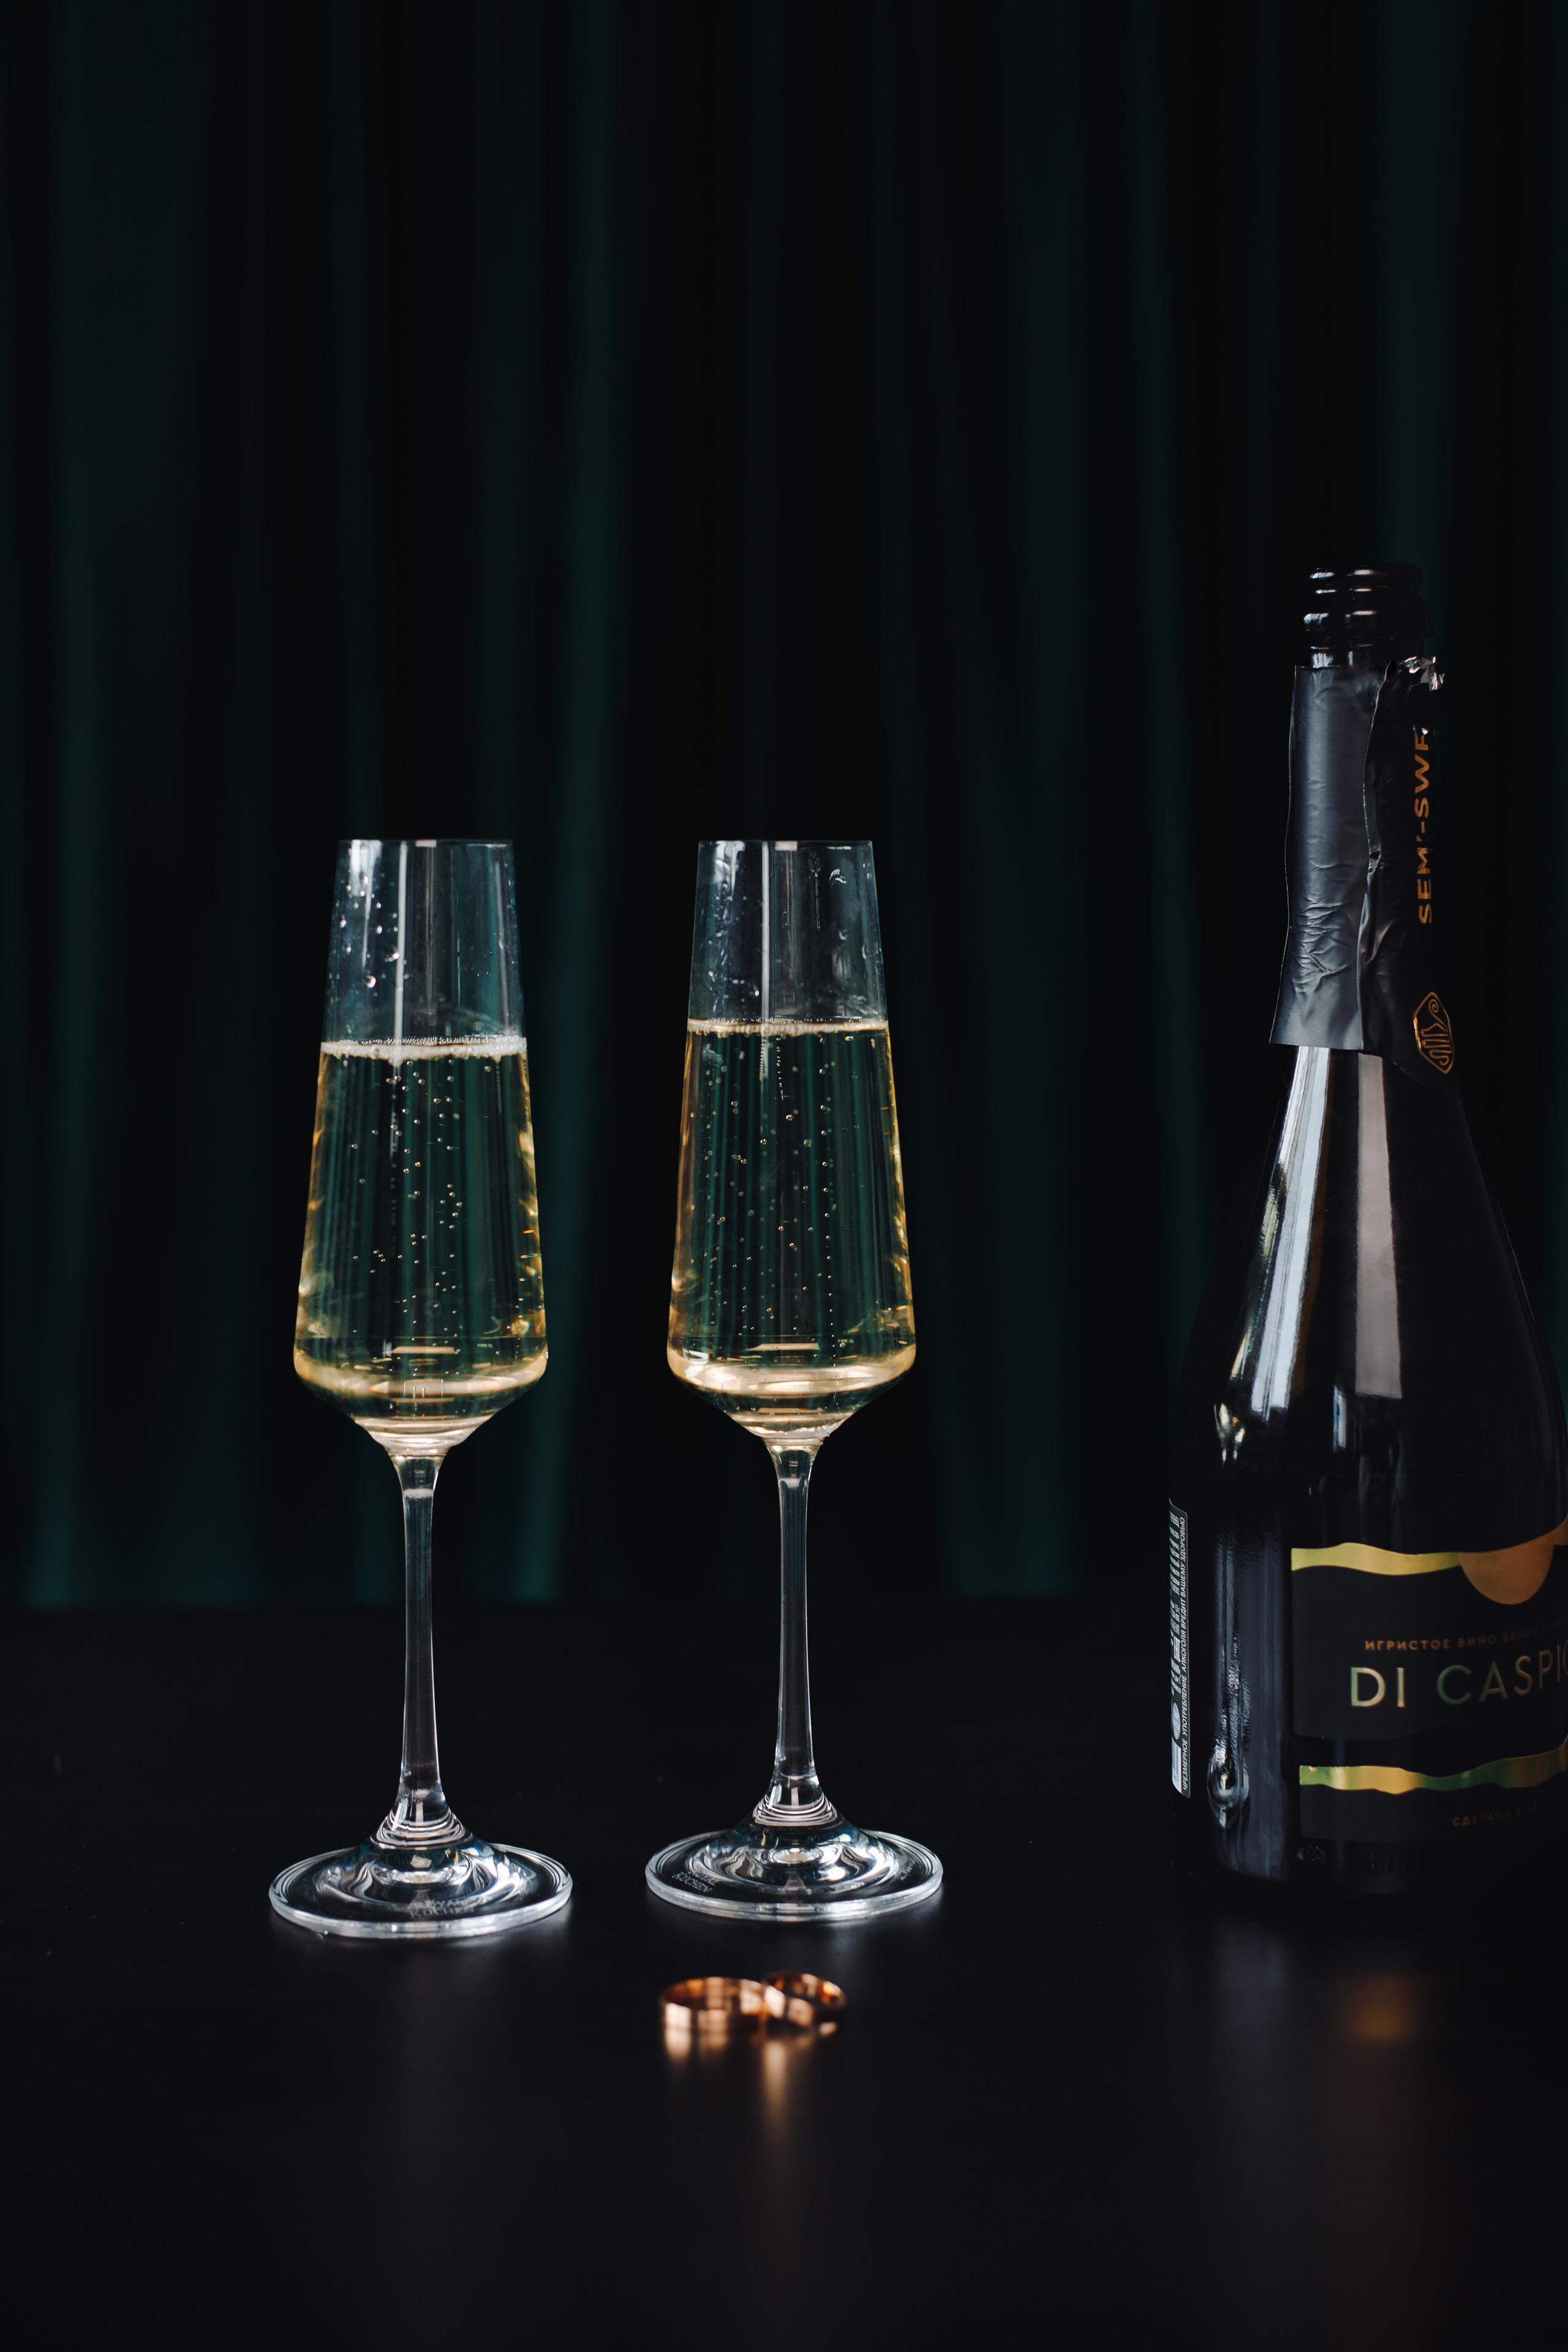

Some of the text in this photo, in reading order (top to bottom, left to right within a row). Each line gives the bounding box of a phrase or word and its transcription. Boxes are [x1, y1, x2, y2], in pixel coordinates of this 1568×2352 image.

[1365, 1626, 1538, 1651] ИГРИСТОЕ ВИНО БЕЛОЕ
[1350, 1666, 1406, 1708] DI
[1452, 1809, 1511, 1827] СДЕЛАНО
